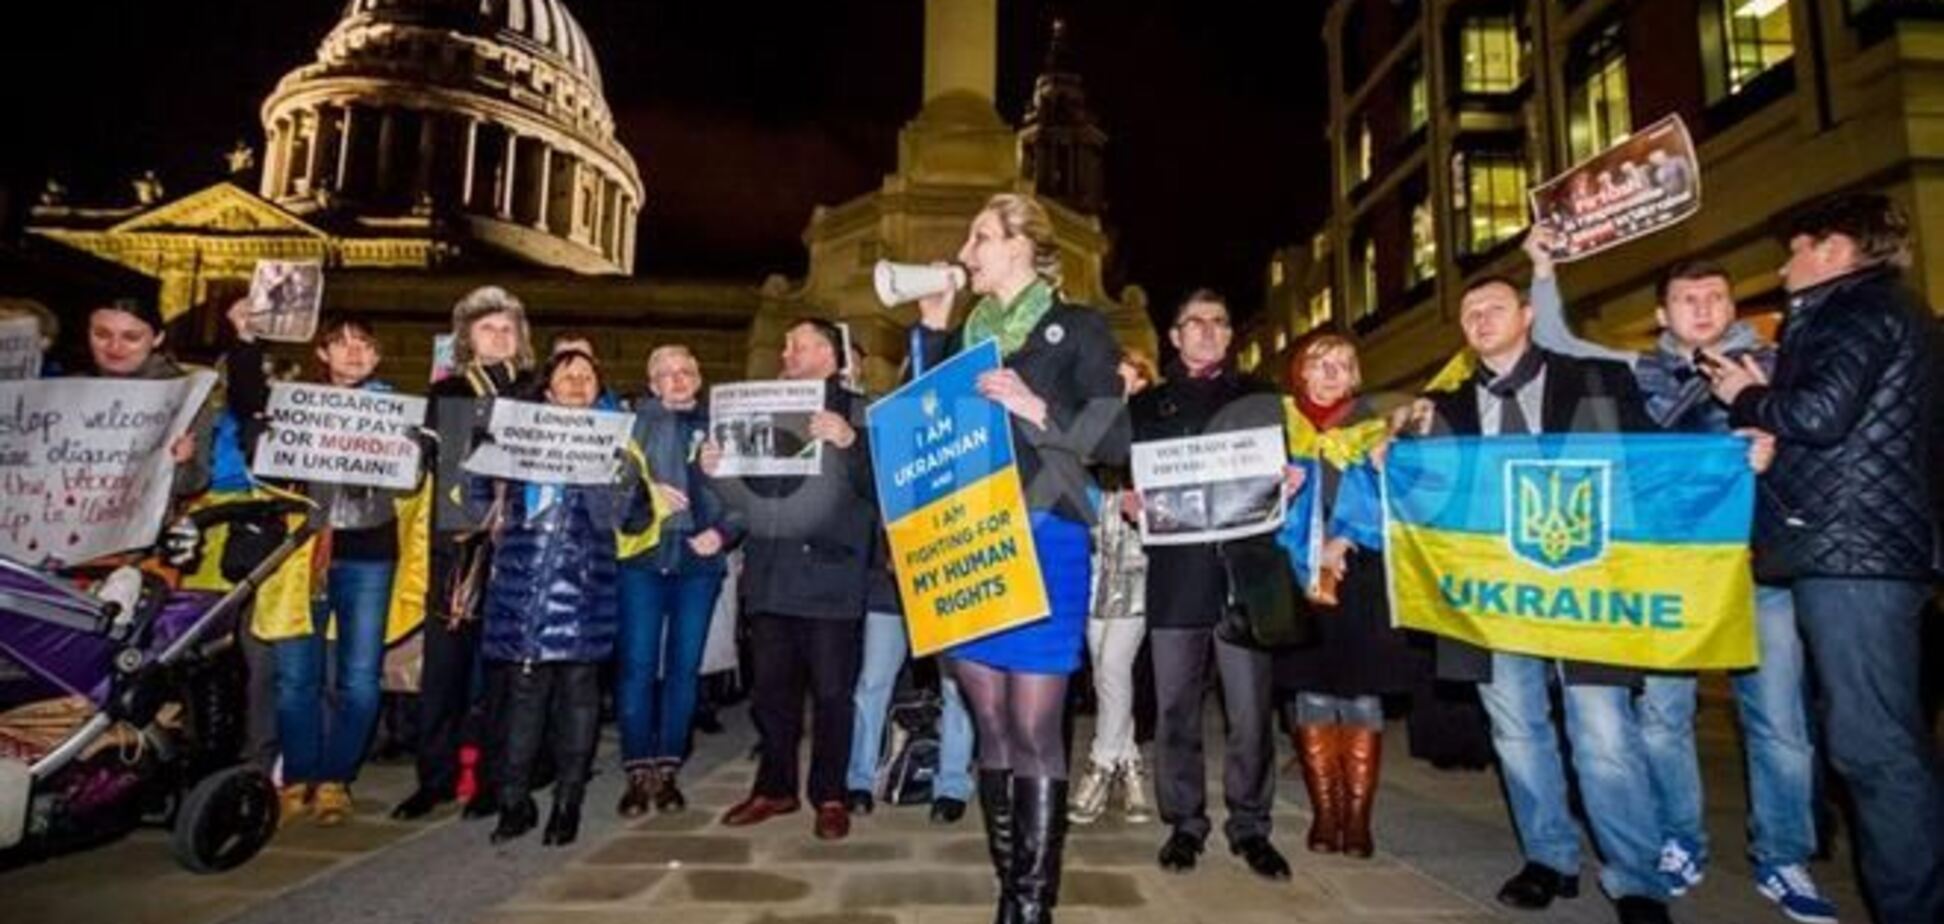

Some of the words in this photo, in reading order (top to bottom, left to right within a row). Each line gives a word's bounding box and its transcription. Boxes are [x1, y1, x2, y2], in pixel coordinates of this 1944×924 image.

[291, 389, 404, 414] OLIGARCH
[273, 409, 351, 430] MONEY
[916, 431, 923, 447] I
[927, 415, 952, 442] AM
[319, 434, 413, 457] MURDER
[894, 427, 989, 487] UKRAINIAN
[273, 450, 296, 466] IN
[303, 452, 400, 477] UKRAINE
[933, 515, 939, 529] I
[943, 503, 965, 526] AM
[907, 527, 974, 565] FIGHTING
[977, 509, 1011, 536] FOR
[913, 568, 938, 595] MY
[943, 536, 1017, 583] HUMAN
[935, 575, 1006, 616] RIGHTS
[1439, 574, 1685, 629] UKRAINE
